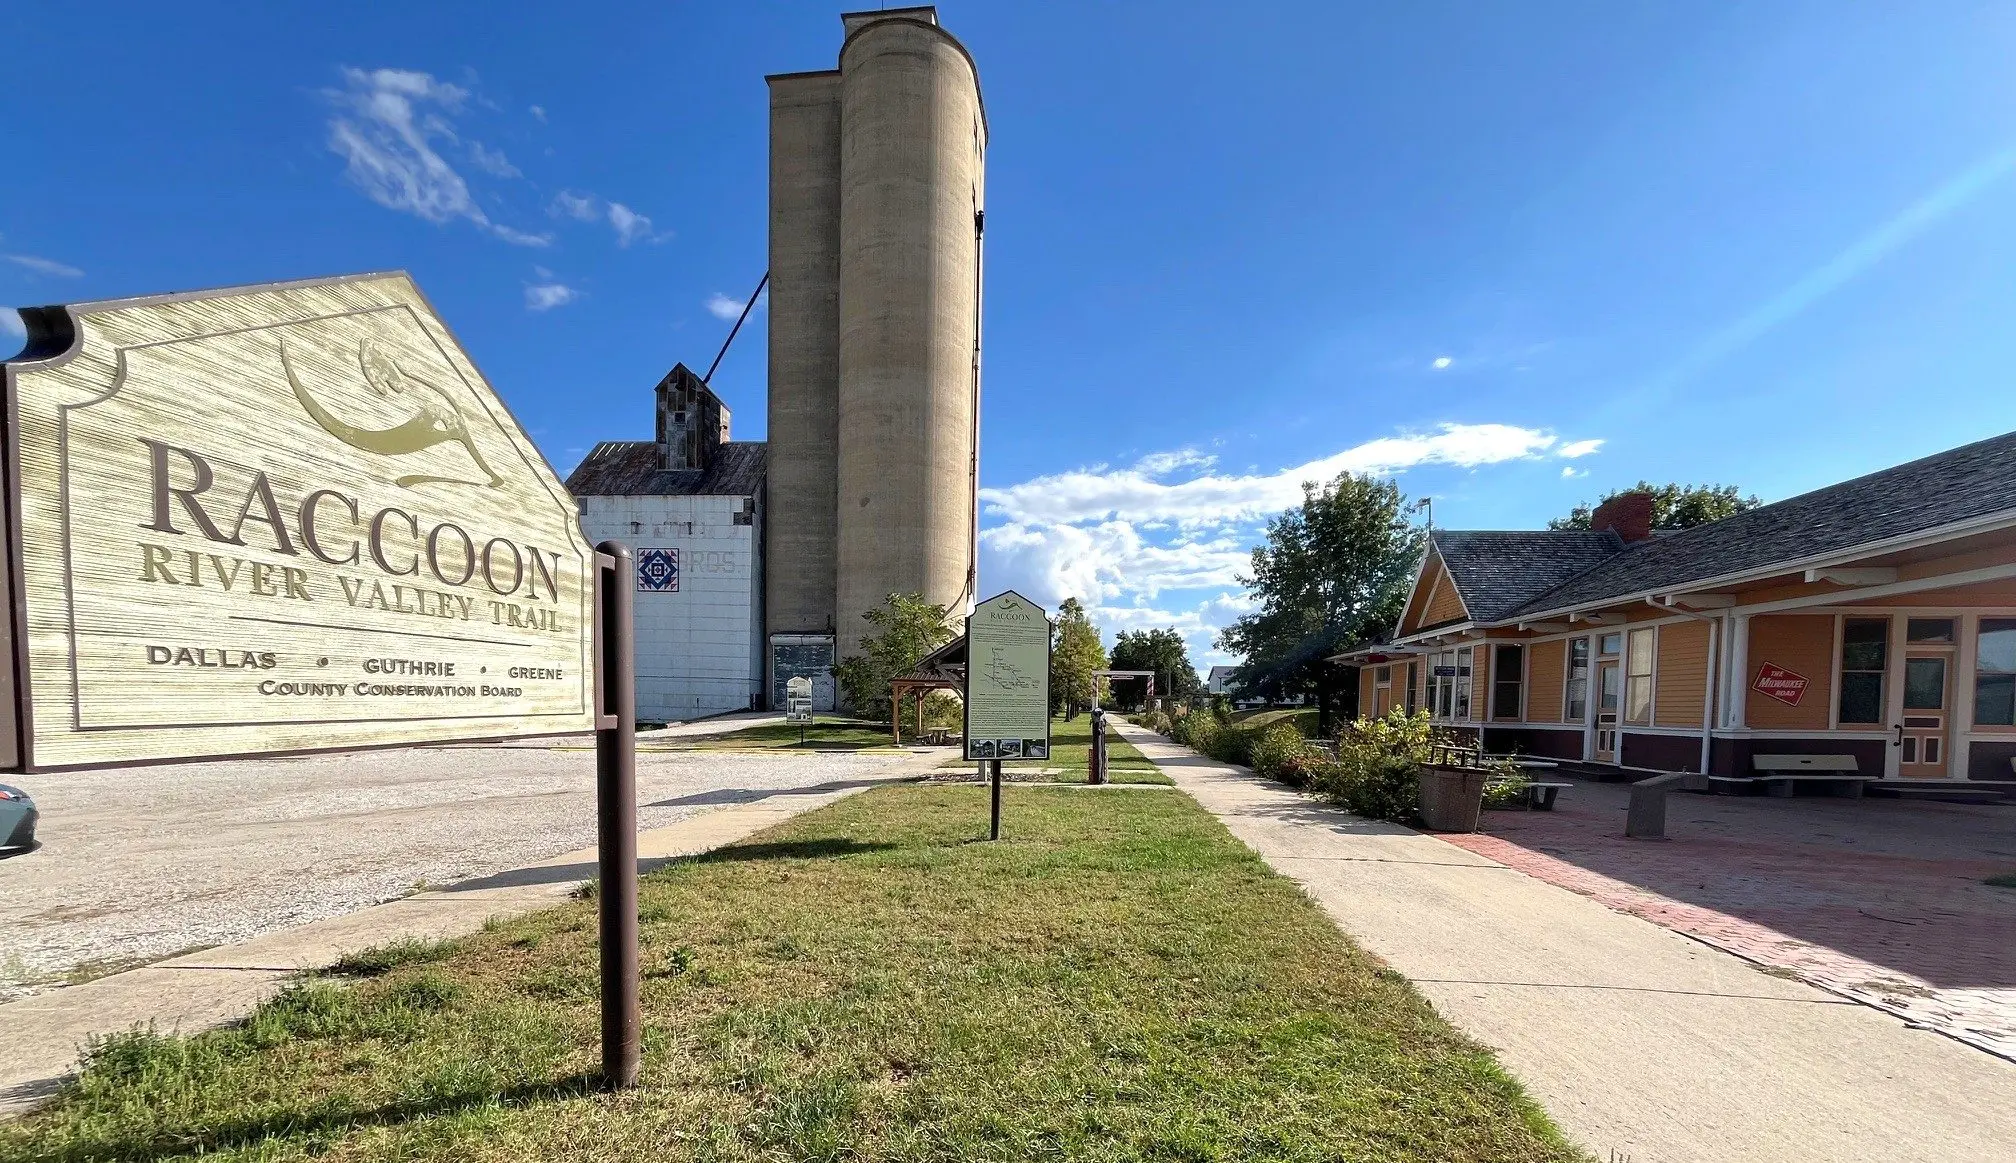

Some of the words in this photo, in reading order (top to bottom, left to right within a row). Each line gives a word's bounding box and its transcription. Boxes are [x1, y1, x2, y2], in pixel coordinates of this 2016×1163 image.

[136, 436, 562, 604] RACCOON
[136, 541, 314, 602] RIVER
[336, 575, 475, 621] VALLEY
[488, 600, 562, 632] TRAIL
[990, 612, 1031, 621] RACCOON
[146, 645, 277, 669] DALLAS
[362, 659, 456, 677] GUTHRIE
[508, 667, 564, 680] GREENE
[1758, 677, 1805, 688] MILWAUKEE
